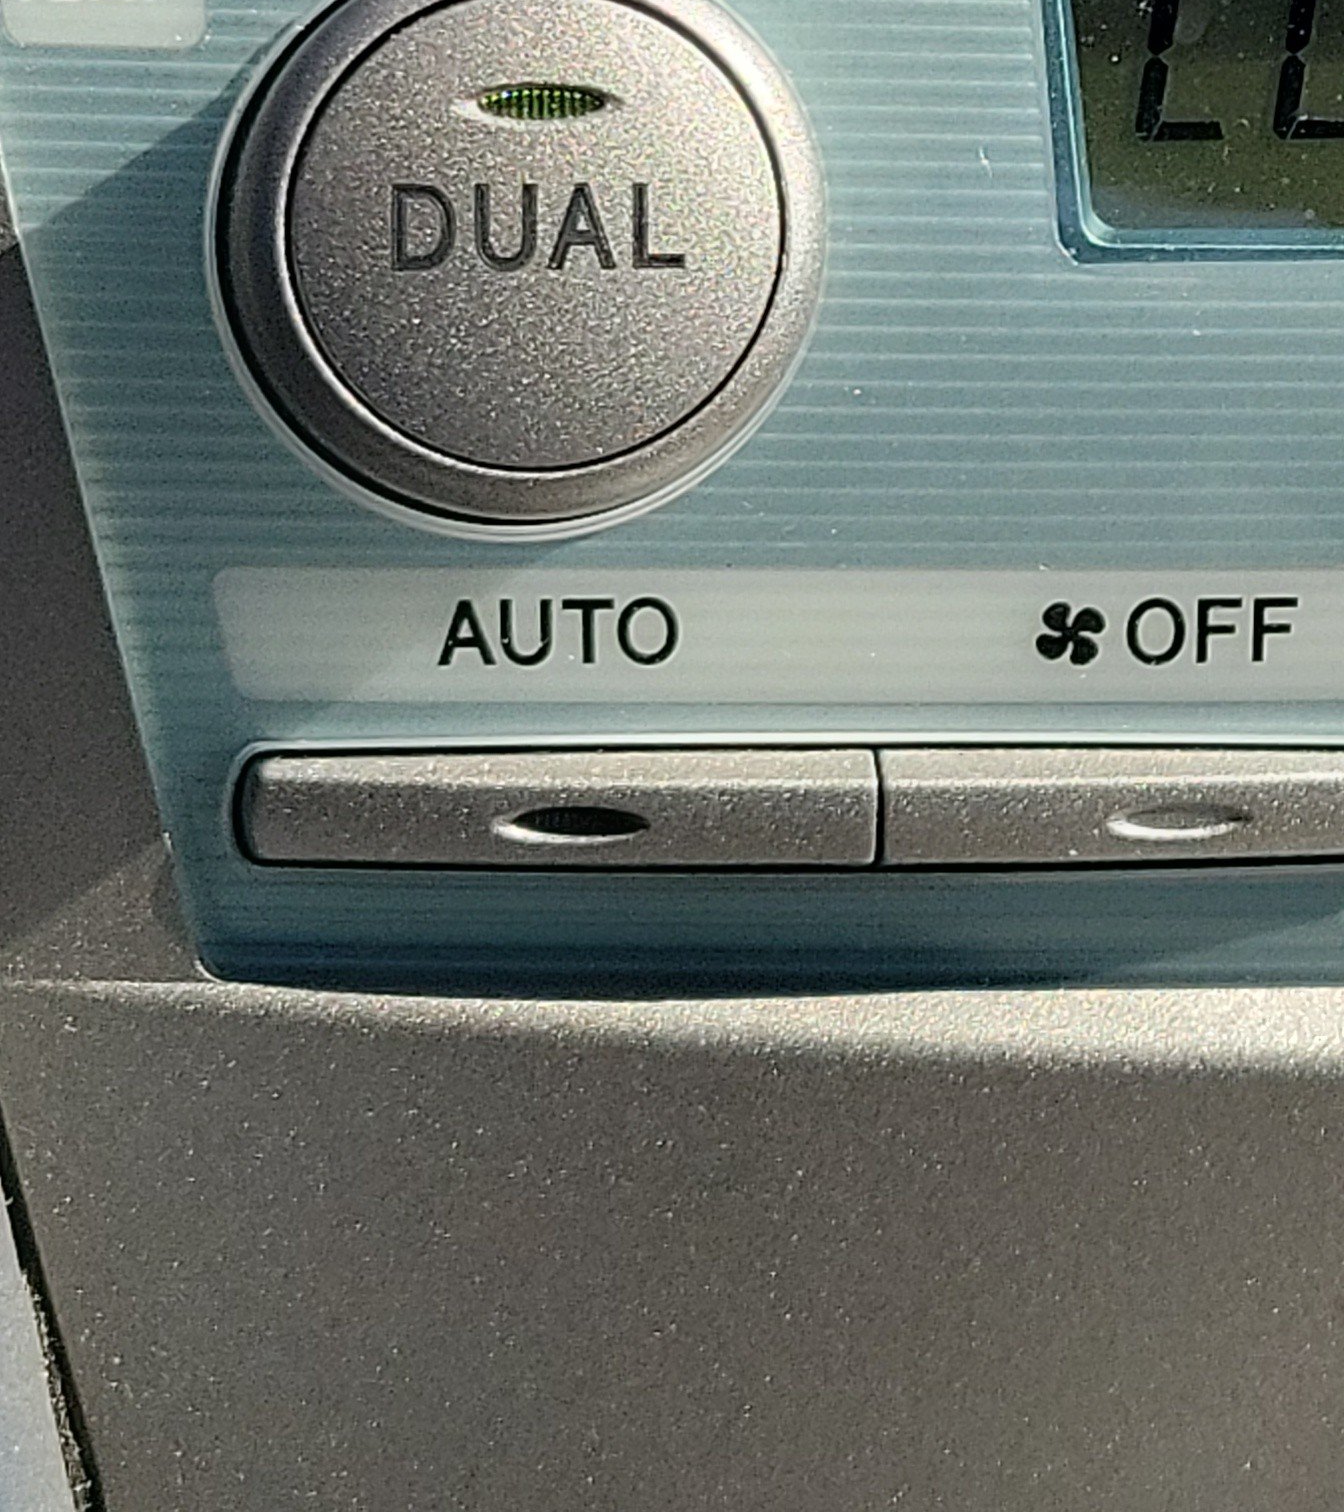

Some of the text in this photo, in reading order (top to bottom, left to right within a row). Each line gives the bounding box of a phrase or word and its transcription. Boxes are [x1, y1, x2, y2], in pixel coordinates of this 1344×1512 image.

[389, 182, 687, 272] DUAL
[437, 595, 681, 668] AUTO
[1124, 595, 1300, 665] OFF
